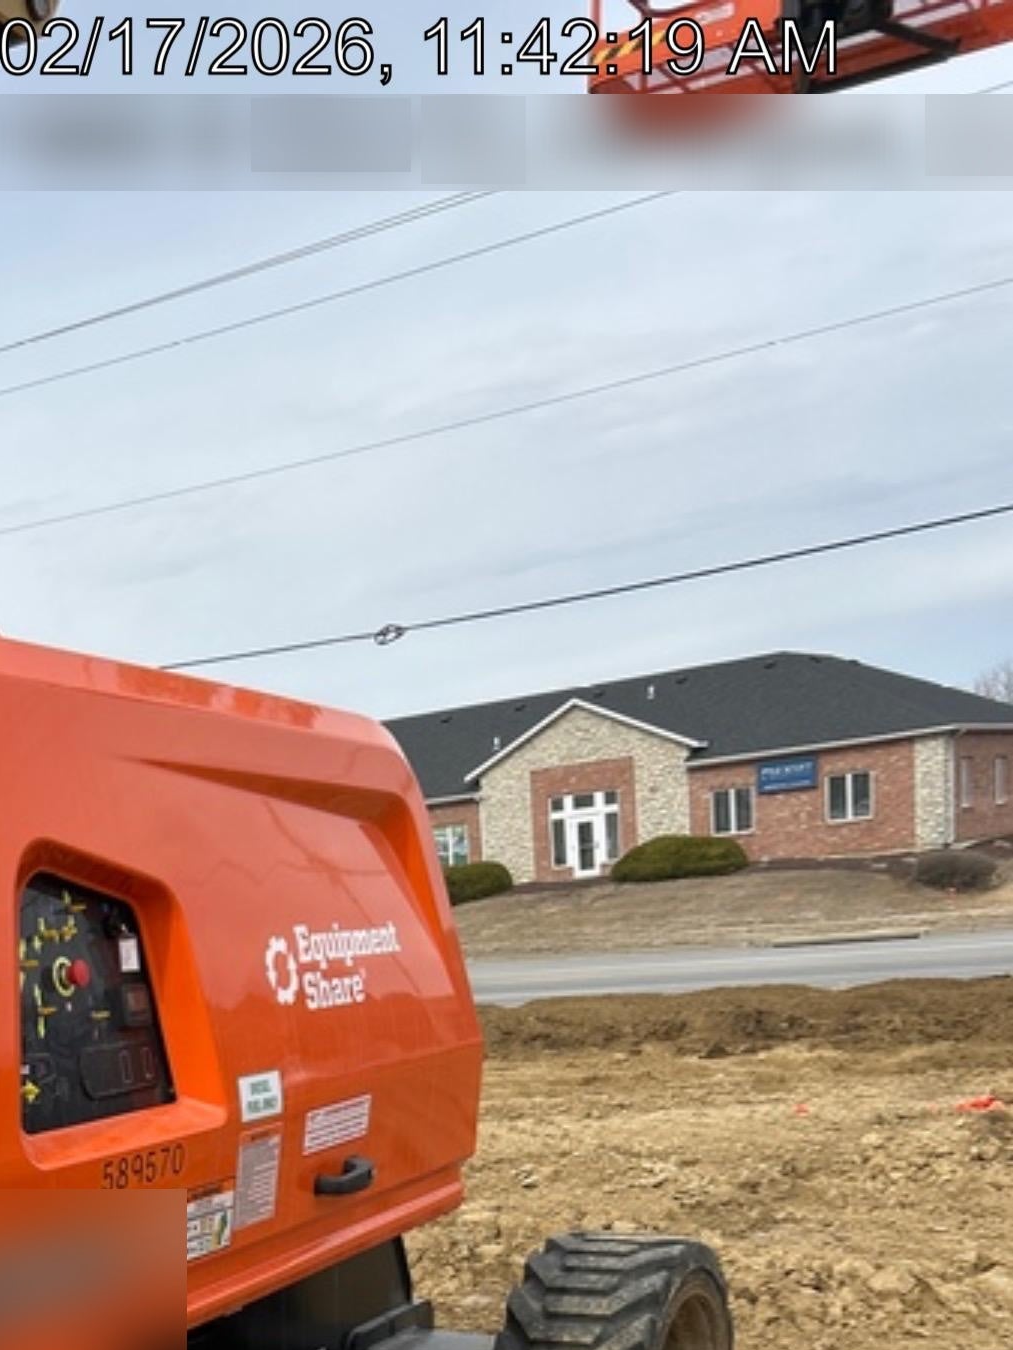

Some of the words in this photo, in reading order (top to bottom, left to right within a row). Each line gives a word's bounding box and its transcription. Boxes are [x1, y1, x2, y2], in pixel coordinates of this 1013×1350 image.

[293, 920, 401, 969] Equipment
[302, 971, 366, 1010] Share
[101, 1142, 185, 1189] 589570
